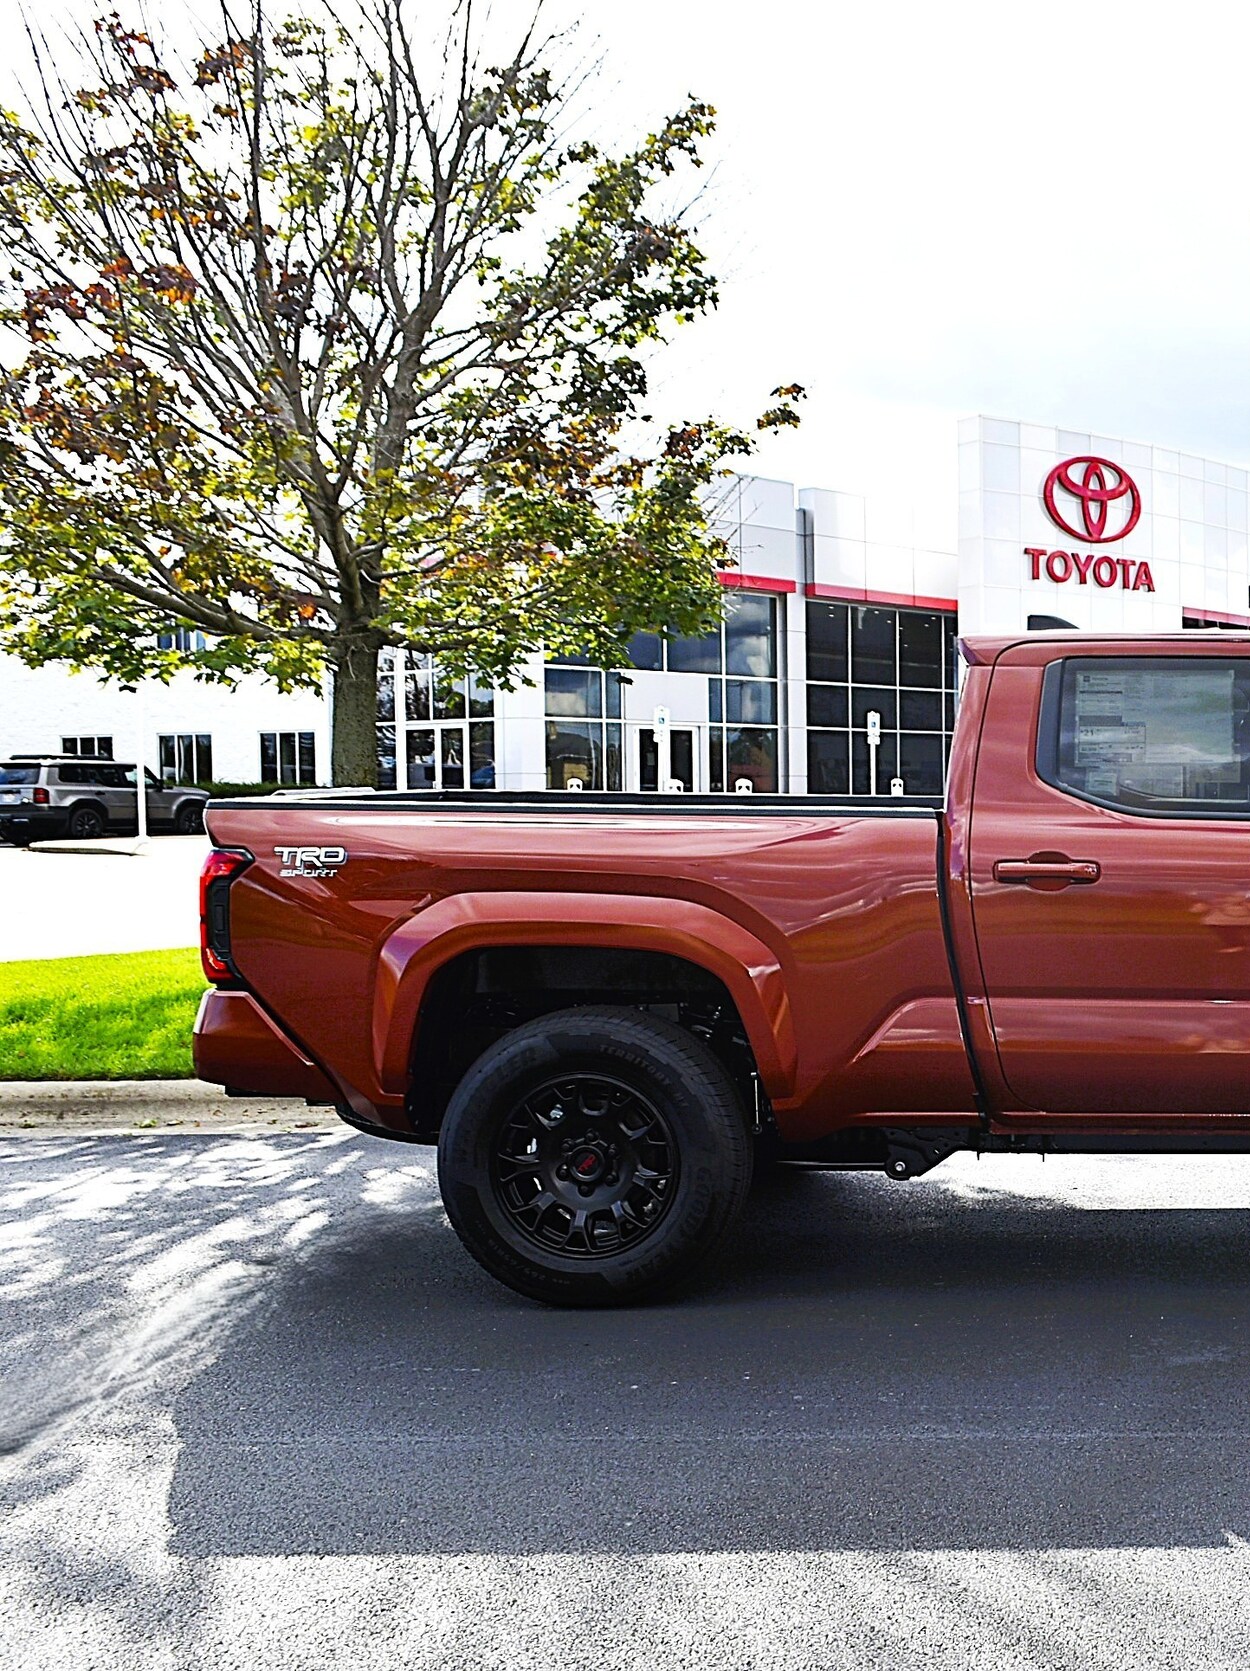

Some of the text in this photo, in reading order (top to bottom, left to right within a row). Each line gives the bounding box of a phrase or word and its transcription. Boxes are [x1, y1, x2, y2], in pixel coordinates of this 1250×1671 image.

[1024, 547, 1155, 592] TOYOTA
[274, 846, 347, 867] TRD
[279, 869, 338, 877] SPORT
